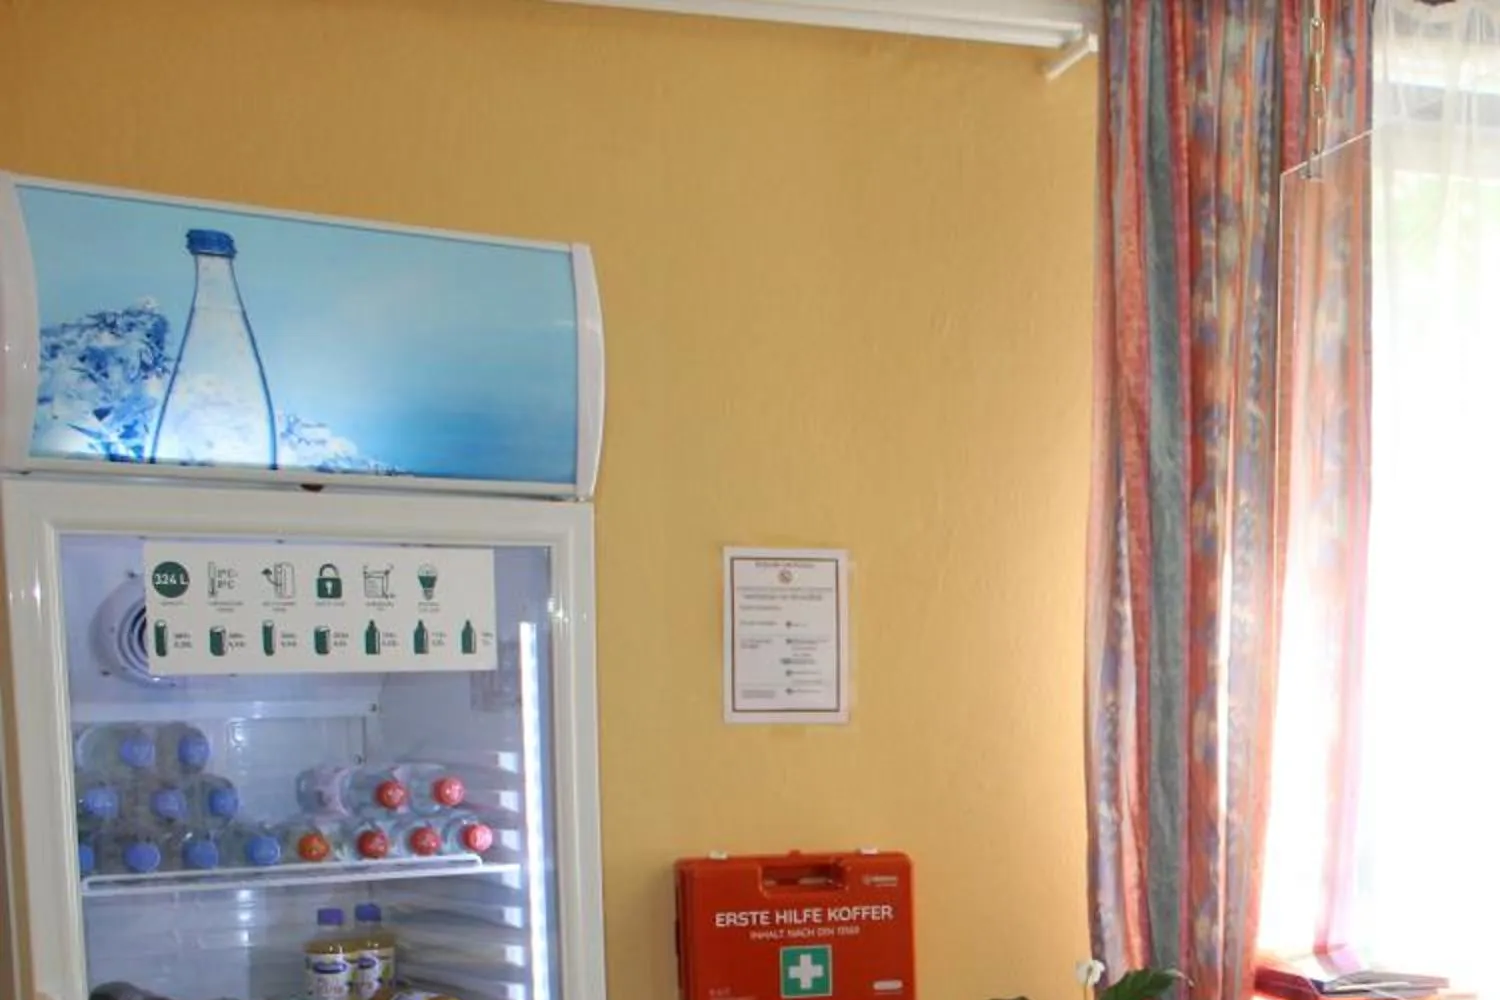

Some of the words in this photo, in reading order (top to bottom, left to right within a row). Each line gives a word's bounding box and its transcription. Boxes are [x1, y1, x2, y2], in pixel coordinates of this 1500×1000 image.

[715, 911, 771, 927] ERSTE
[775, 908, 822, 924] HILFE
[827, 905, 894, 921] KOFFER
[749, 929, 784, 940] INHALT
[787, 927, 815, 938] NACH
